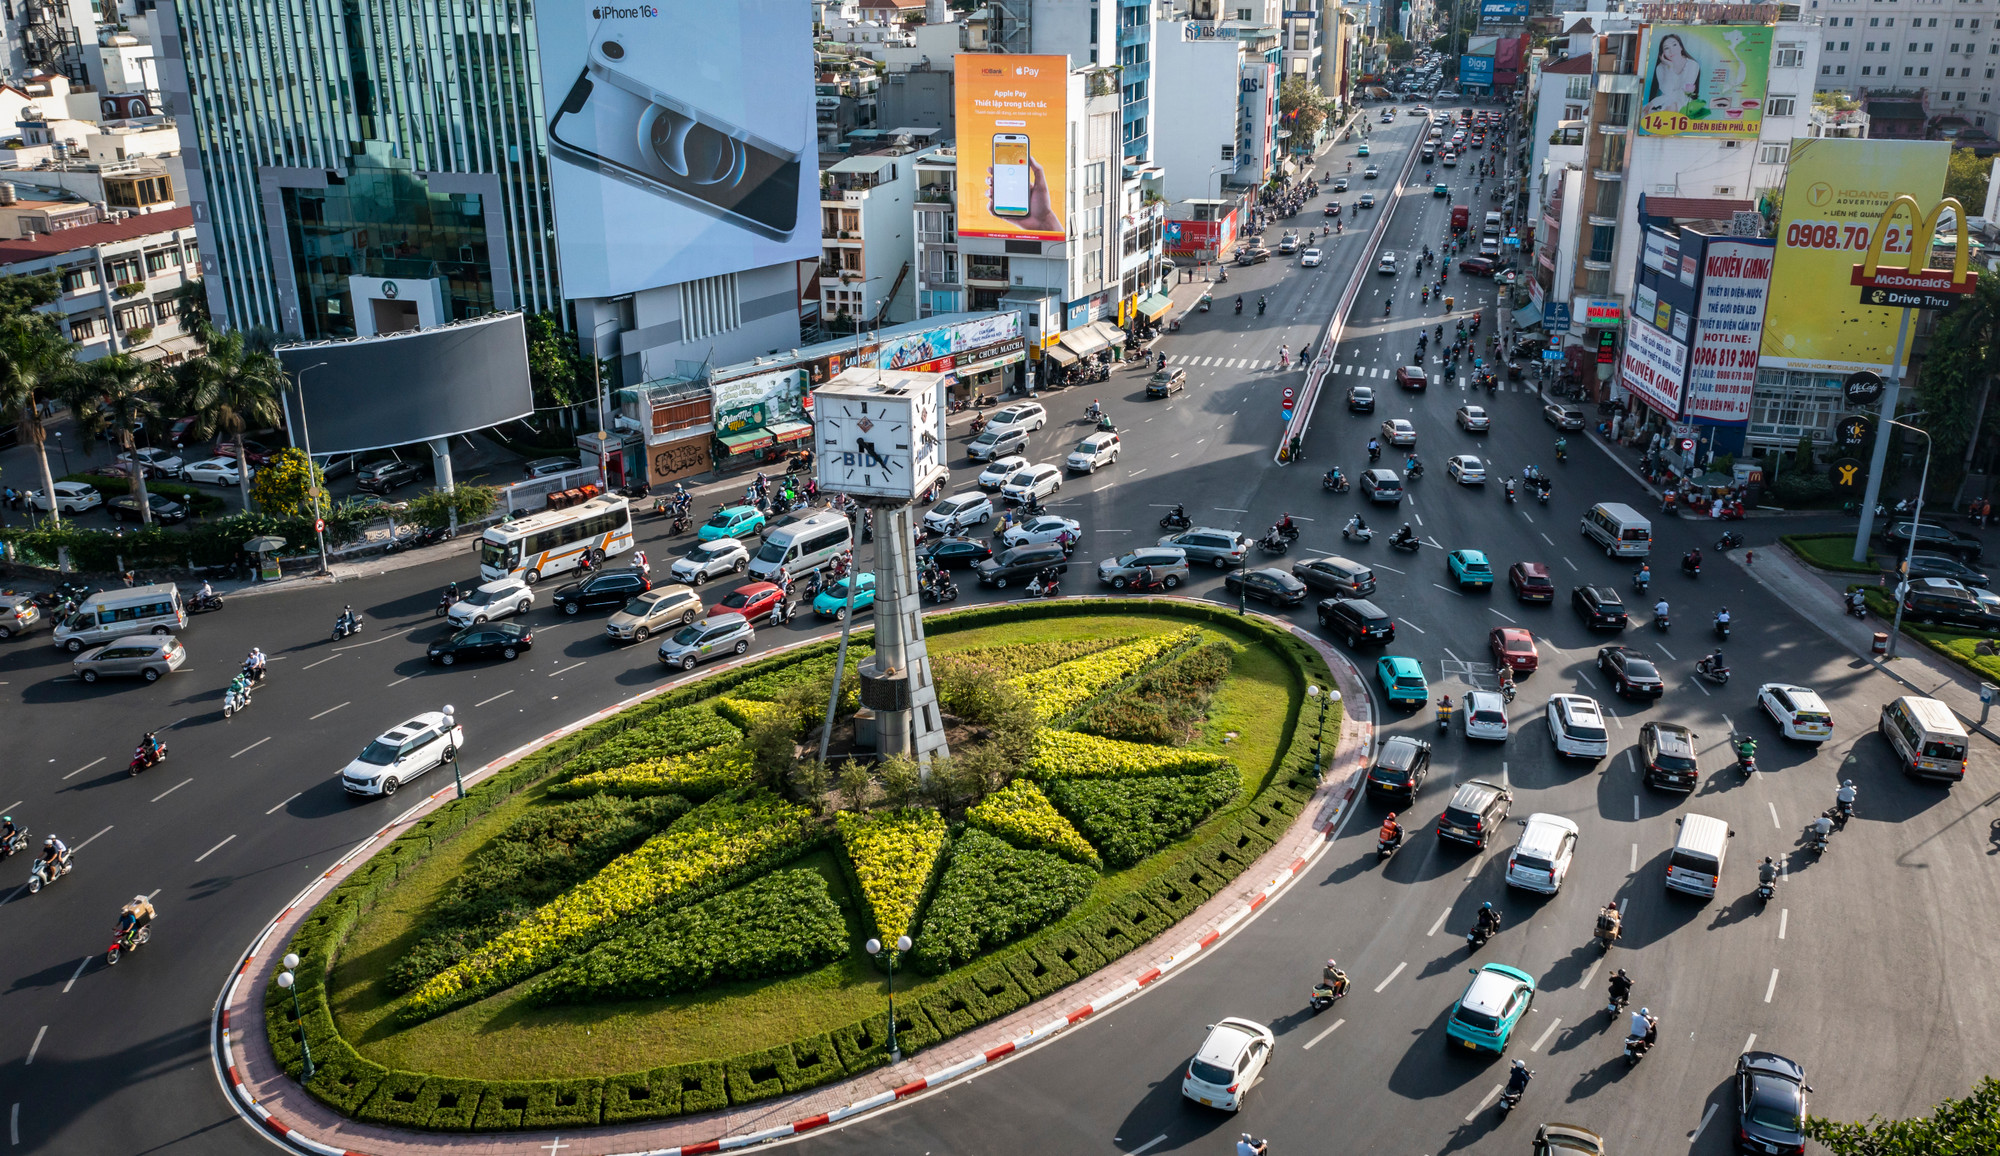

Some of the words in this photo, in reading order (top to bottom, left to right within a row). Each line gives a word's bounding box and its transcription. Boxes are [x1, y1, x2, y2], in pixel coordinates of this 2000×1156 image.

[602, 6, 638, 19] iPhone
[639, 5, 658, 18] 16e
[1024, 67, 1039, 77] Pay
[1645, 116, 1688, 130] 14-16
[1693, 122, 1709, 131] ĐIỆN
[1838, 190, 1888, 199] HOANG
[1787, 224, 1912, 253] 0908.70.2.7
[1706, 249, 1743, 278] NGUYỄN
[1743, 258, 1770, 279] GIANG
[1875, 275, 1951, 288] McDonald's
[1708, 285, 1723, 297] THIẾT
[1724, 288, 1729, 299] BỊ
[1889, 293, 1920, 304] Drive
[1925, 296, 1949, 306] Thru
[1606, 308, 1620, 318] ANH
[1708, 302, 1719, 313] THẾ
[1720, 302, 1732, 313] GIỚI
[1733, 302, 1745, 314] ĐÈN
[1746, 306, 1756, 315] LED
[1700, 317, 1715, 329] THIẾT
[1723, 318, 1736, 330] ĐIỆN
[1751, 322, 1761, 331] TAY
[1704, 333, 1751, 344] HOTLINE:
[1000, 342, 1024, 352] MATCHA
[1694, 347, 1717, 366] 0906
[1719, 348, 1736, 367] 819
[1739, 350, 1756, 368] 300
[1625, 354, 1656, 385] NGUYỄN
[1656, 374, 1679, 401] GIANG
[1692, 369, 1716, 379] Đ-ZALO:
[1691, 383, 1714, 392] Đ-ZALO:
[1696, 397, 1708, 412] ĐIỆN
[1710, 398, 1722, 410] BIÊN
[1723, 398, 1735, 412] PHỦ
[1739, 402, 1748, 413] Q.1
[844, 452, 890, 467] BIDV
